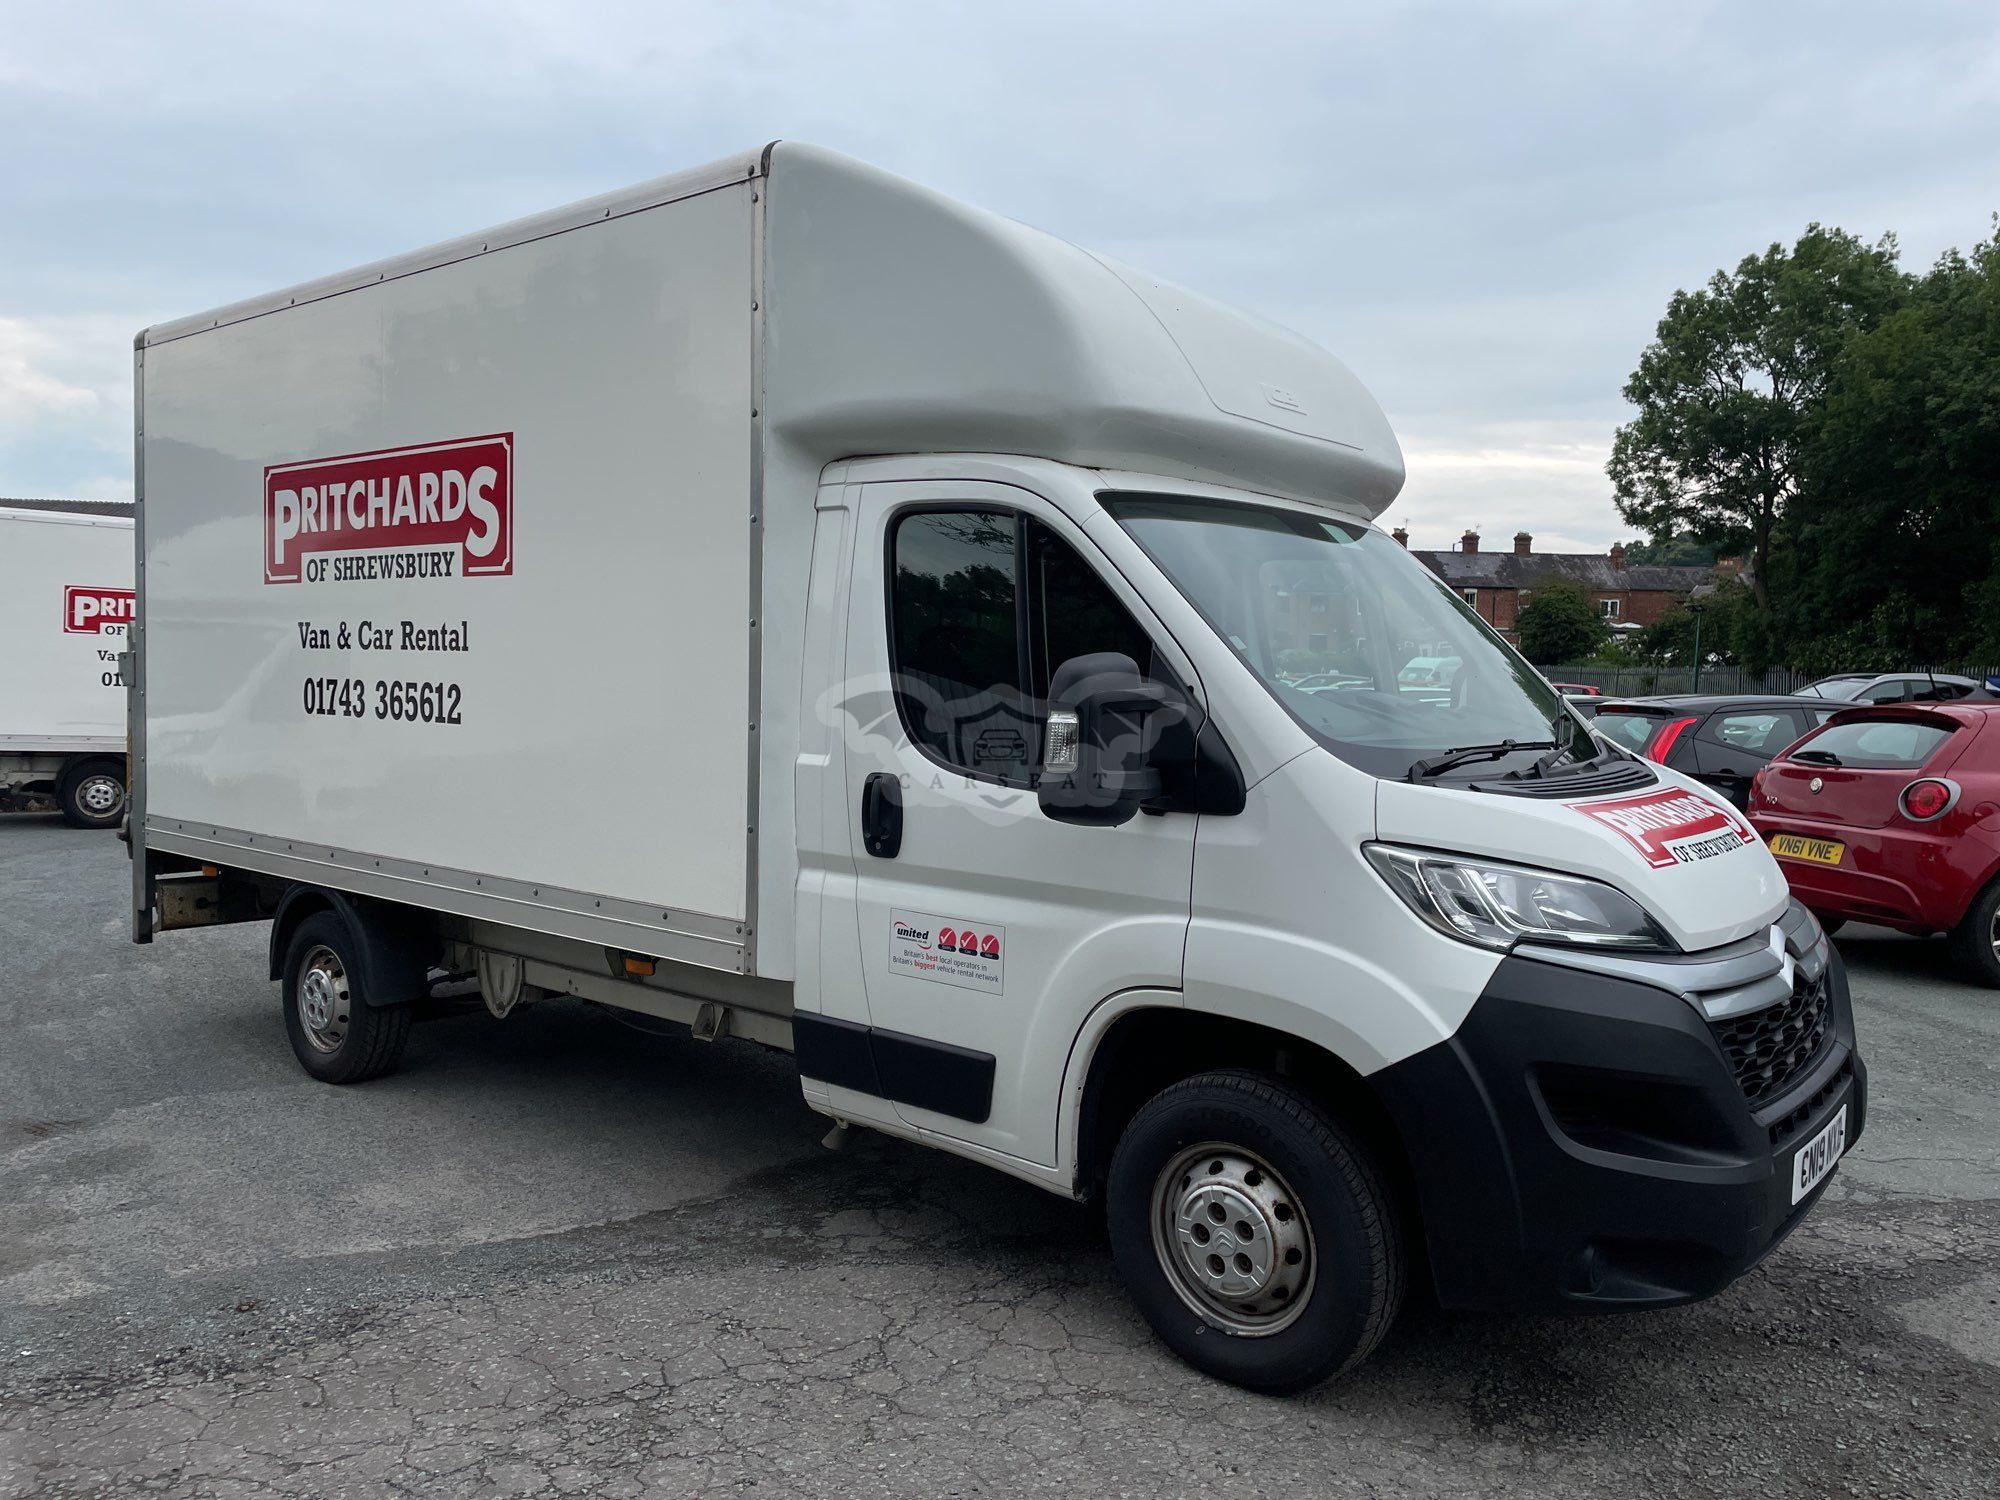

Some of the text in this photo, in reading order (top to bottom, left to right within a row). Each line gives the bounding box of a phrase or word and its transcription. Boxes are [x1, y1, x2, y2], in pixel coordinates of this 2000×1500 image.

[274, 465, 500, 565] PRITCHARDS
[306, 551, 455, 583] OF SHREWSBURY
[105, 625, 125, 635] OF
[298, 620, 469, 652] Van & Car Rental
[97, 650, 120, 661] Va
[102, 672, 127, 686] 01
[303, 677, 462, 725] 01743 365612
[1592, 795, 1742, 853] PRITCHARDS
[1672, 831, 1744, 863] OF SHREWSBURY
[1778, 836, 1835, 860] VN61 VNE
[897, 927, 929, 940] united
[914, 959, 935, 970] biggest
[937, 964, 956, 974] vehicle
[957, 967, 974, 978] rental
[975, 973, 999, 983] network
[925, 953, 938, 962] best
[939, 956, 953, 965] local
[953, 959, 981, 971] operators
